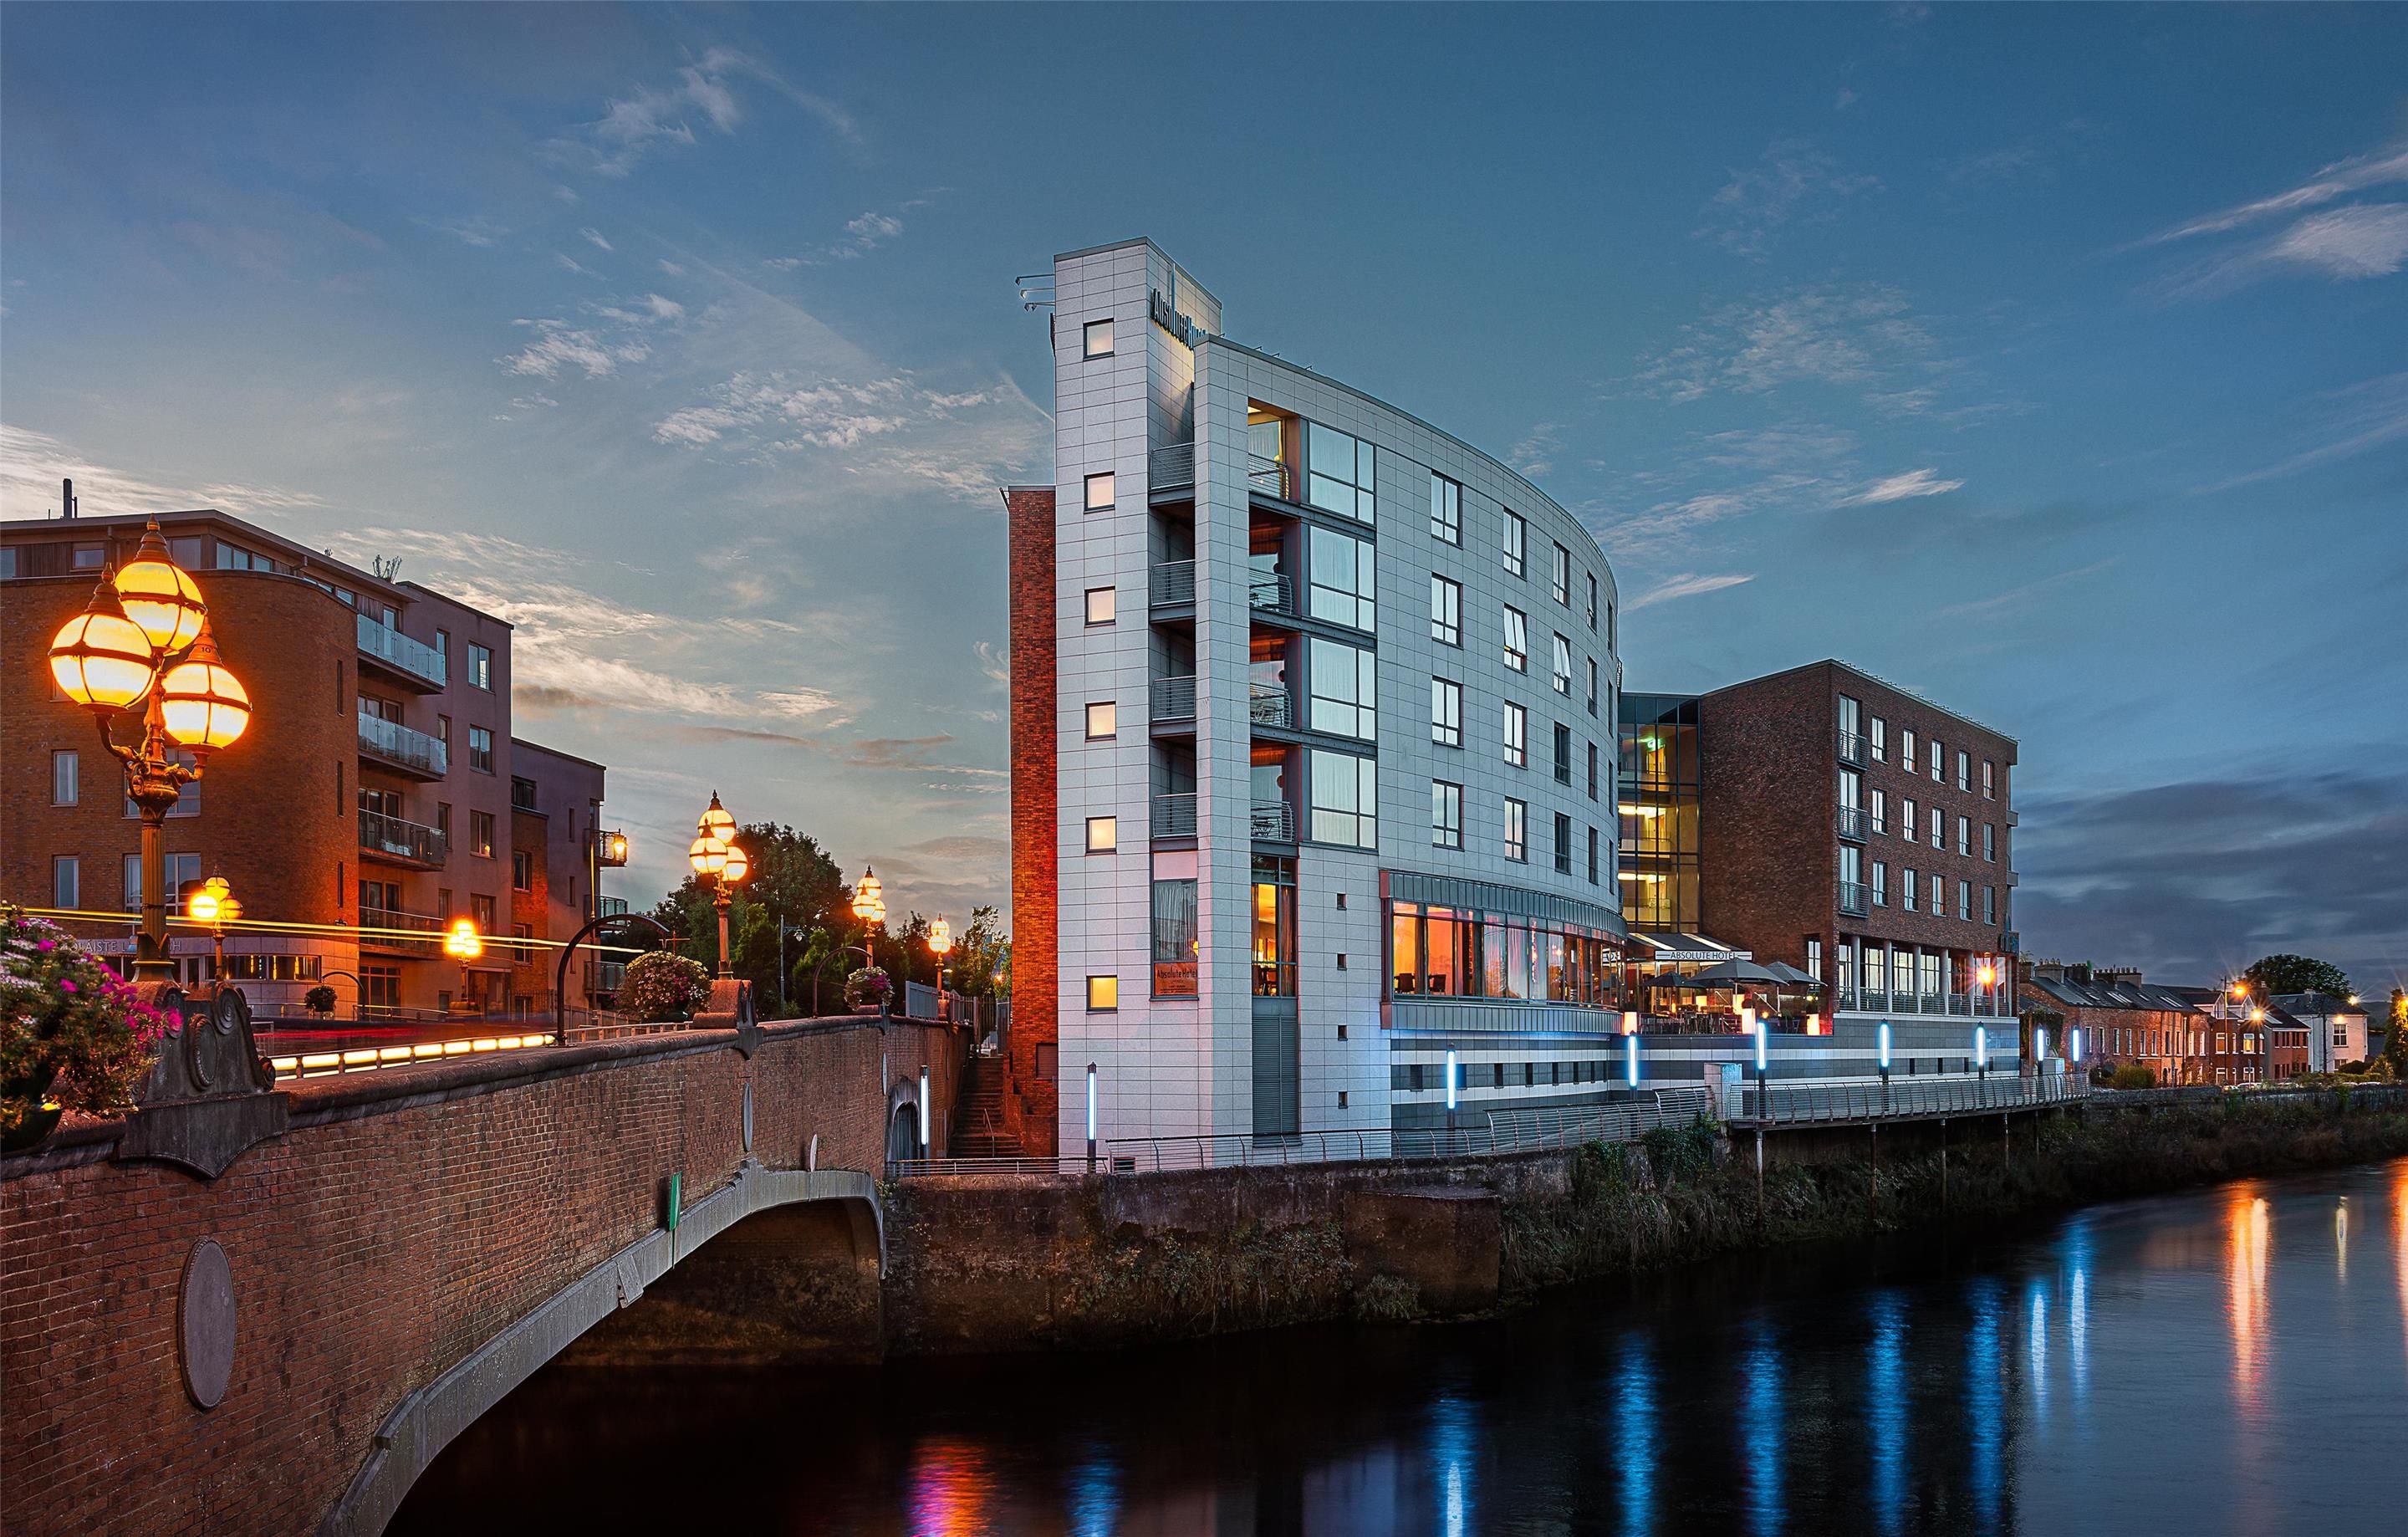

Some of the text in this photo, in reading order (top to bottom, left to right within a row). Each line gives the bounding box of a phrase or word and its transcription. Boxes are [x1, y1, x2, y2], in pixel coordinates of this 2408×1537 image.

[1671, 952, 1737, 960] ABSOLUTE HOTEL
[1157, 965, 1181, 978] Absolute
